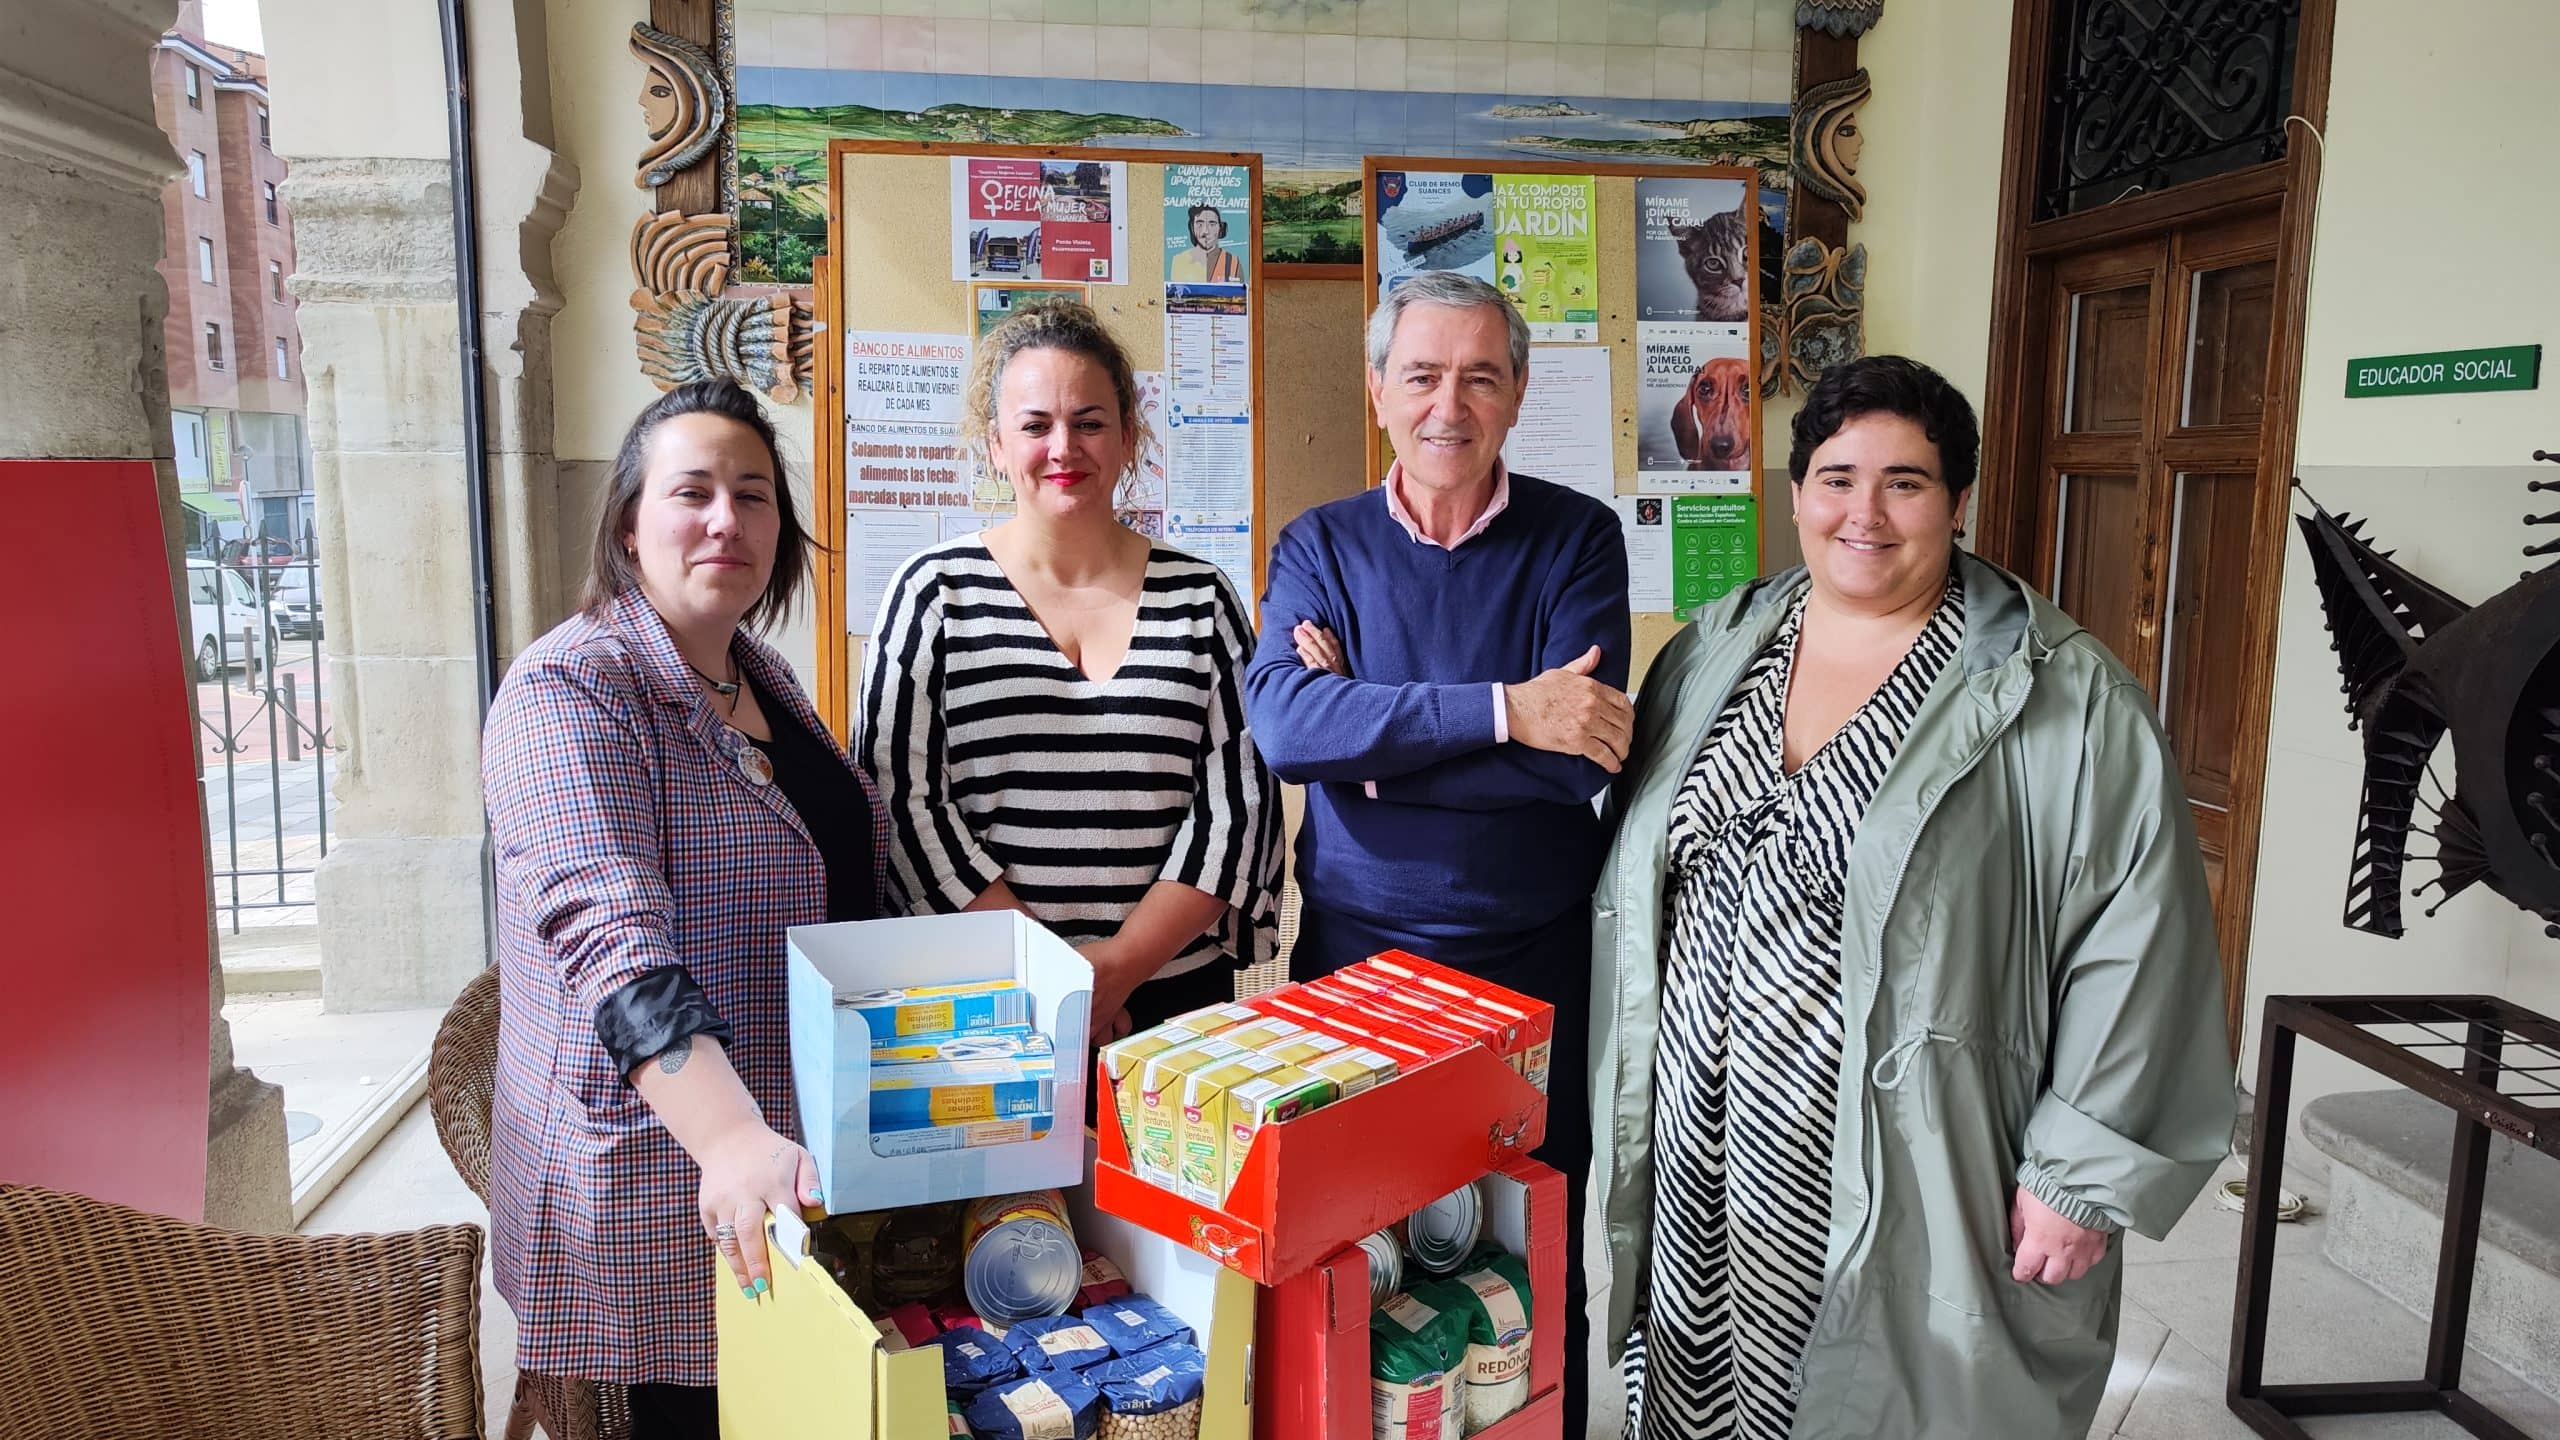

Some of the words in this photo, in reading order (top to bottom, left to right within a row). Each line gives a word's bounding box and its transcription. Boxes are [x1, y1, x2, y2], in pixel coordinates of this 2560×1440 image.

[1215, 166, 1234, 176] HAY
[1170, 175, 1241, 187] OPORTUNIDADES
[1519, 184, 1587, 197] COMPOST
[1163, 197, 1202, 208] SALIMOS
[1203, 197, 1250, 209] ADELANTE
[1511, 196, 1530, 209] TU
[1533, 197, 1587, 210] PROPIO
[1645, 195, 1689, 208] MÍRAME
[1004, 200, 1018, 212] DE
[1025, 201, 1042, 213] LA
[1046, 201, 1088, 216] MUJER
[1645, 207, 1690, 219] ¡DÍMELO
[1646, 218, 1655, 227] A
[1656, 218, 1670, 227] LA
[1671, 217, 1705, 227] CARA!
[852, 342, 889, 356] BANCO
[891, 343, 905, 357] DE
[906, 345, 965, 359] ALIMENTOS
[1646, 343, 1690, 354] MÍRAME
[1646, 354, 1692, 366] ¡DÍMELO
[858, 362, 867, 374] EL
[868, 363, 900, 376] REPARTO
[901, 364, 910, 376] DE
[911, 365, 949, 378] ALIMENTOS
[950, 366, 959, 378] SE
[1647, 365, 1656, 374] A
[1657, 365, 1671, 374] LA
[1672, 365, 1705, 374] CARA!
[2358, 364, 2445, 387] EDUCADOR
[2453, 359, 2517, 381] SOCIAL
[896, 381, 905, 393] EL
[931, 383, 960, 396] VIERNES
[885, 398, 896, 410] DE
[896, 398, 915, 410] CADA
[851, 423, 876, 433] BANCO
[877, 424, 887, 433] DE
[888, 424, 927, 434] ALIMENTOS
[928, 425, 939, 434] DE
[851, 441, 904, 458] Solamente
[905, 446, 917, 459] se
[860, 465, 909, 482] alimentos
[910, 467, 925, 482] las
[926, 467, 960, 483] fechas
[848, 489, 898, 505] marcadas
[899, 491, 922, 507] para
[922, 490, 936, 506] tal
[937, 491, 970, 507] efecto.
[1676, 504, 1710, 512] Servicios
[1711, 503, 1746, 513] gratuitos
[907, 1013, 948, 1022] Sardinhas
[911, 1021, 948, 1030] Sardinas
[941, 1096, 986, 1106] Sardinhas
[947, 1104, 987, 1113] Sardinas
[1477, 1349, 1530, 1375] REDOND
